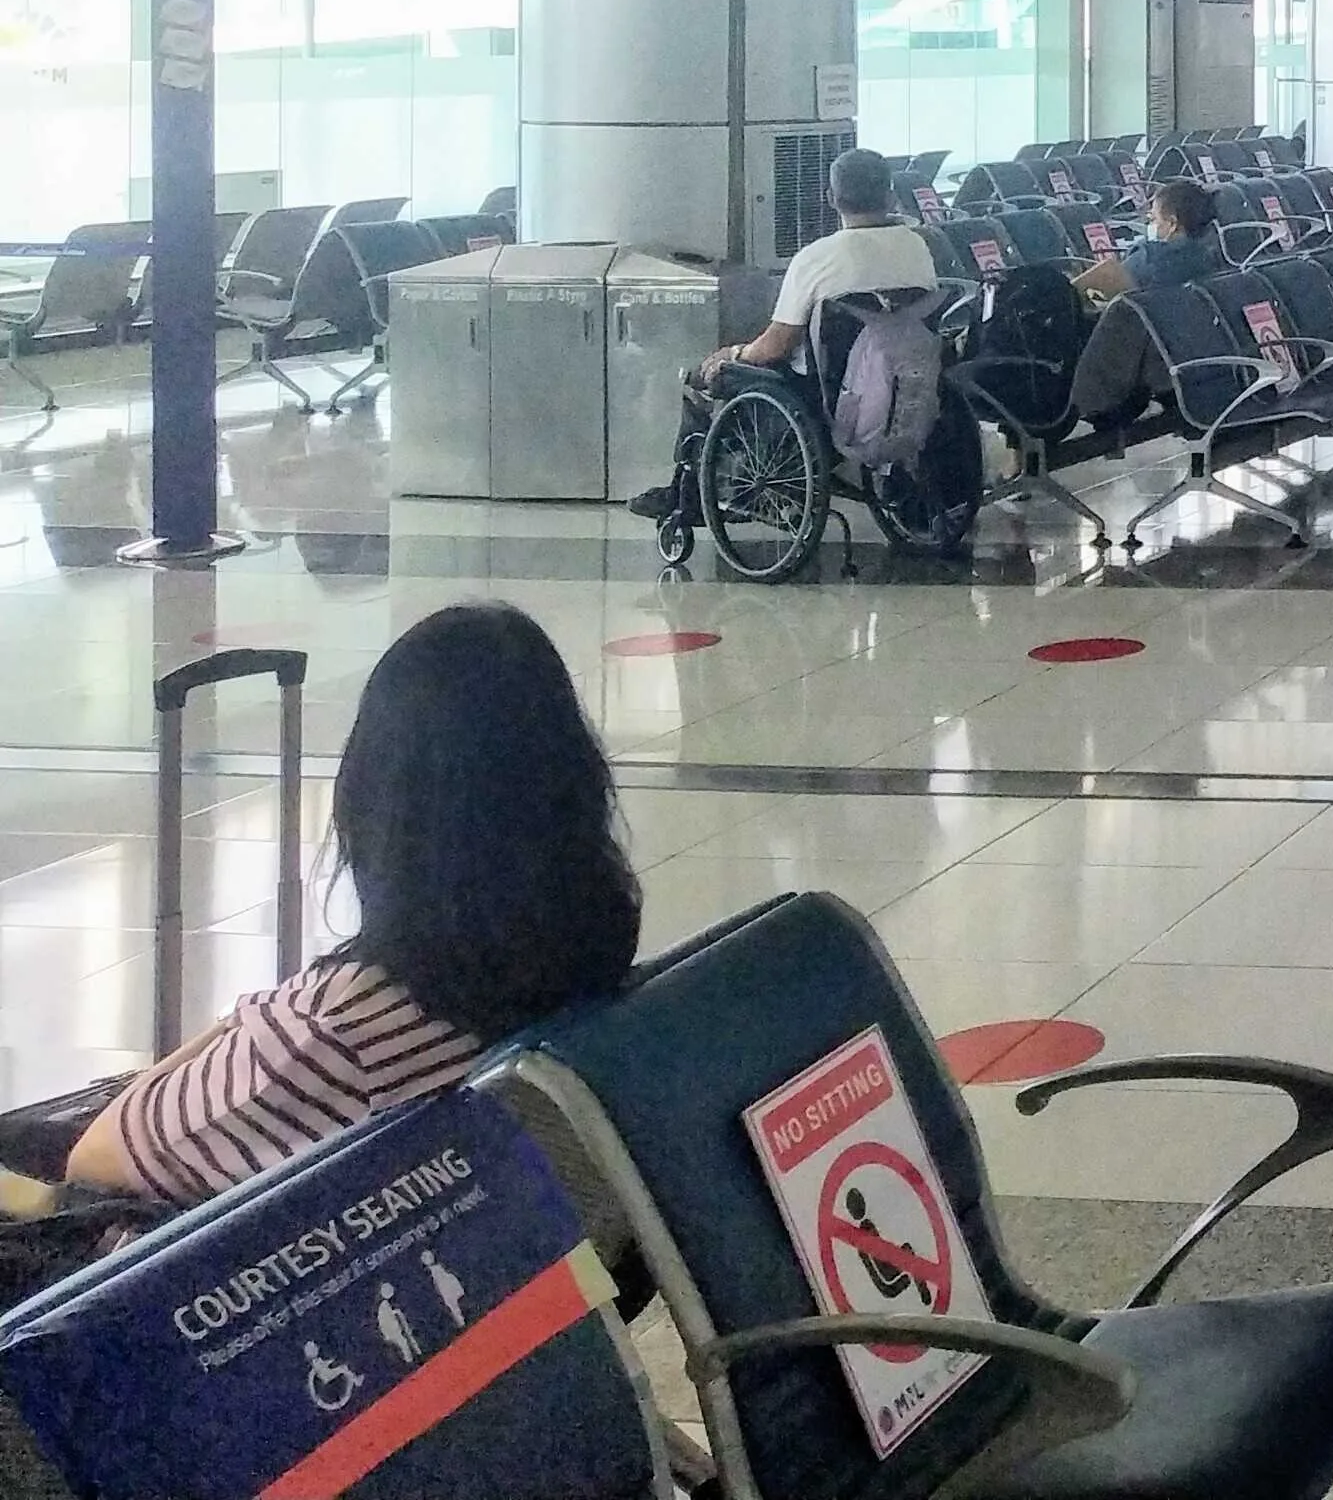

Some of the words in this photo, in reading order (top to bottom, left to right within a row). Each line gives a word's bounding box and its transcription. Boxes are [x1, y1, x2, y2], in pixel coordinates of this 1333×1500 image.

[772, 1117, 805, 1154] NO
[805, 1063, 884, 1131] SITTING
[173, 1219, 346, 1340] COURTESY
[342, 1148, 473, 1240] SEATING
[199, 1328, 255, 1371] Please
[249, 1303, 295, 1341] offer
